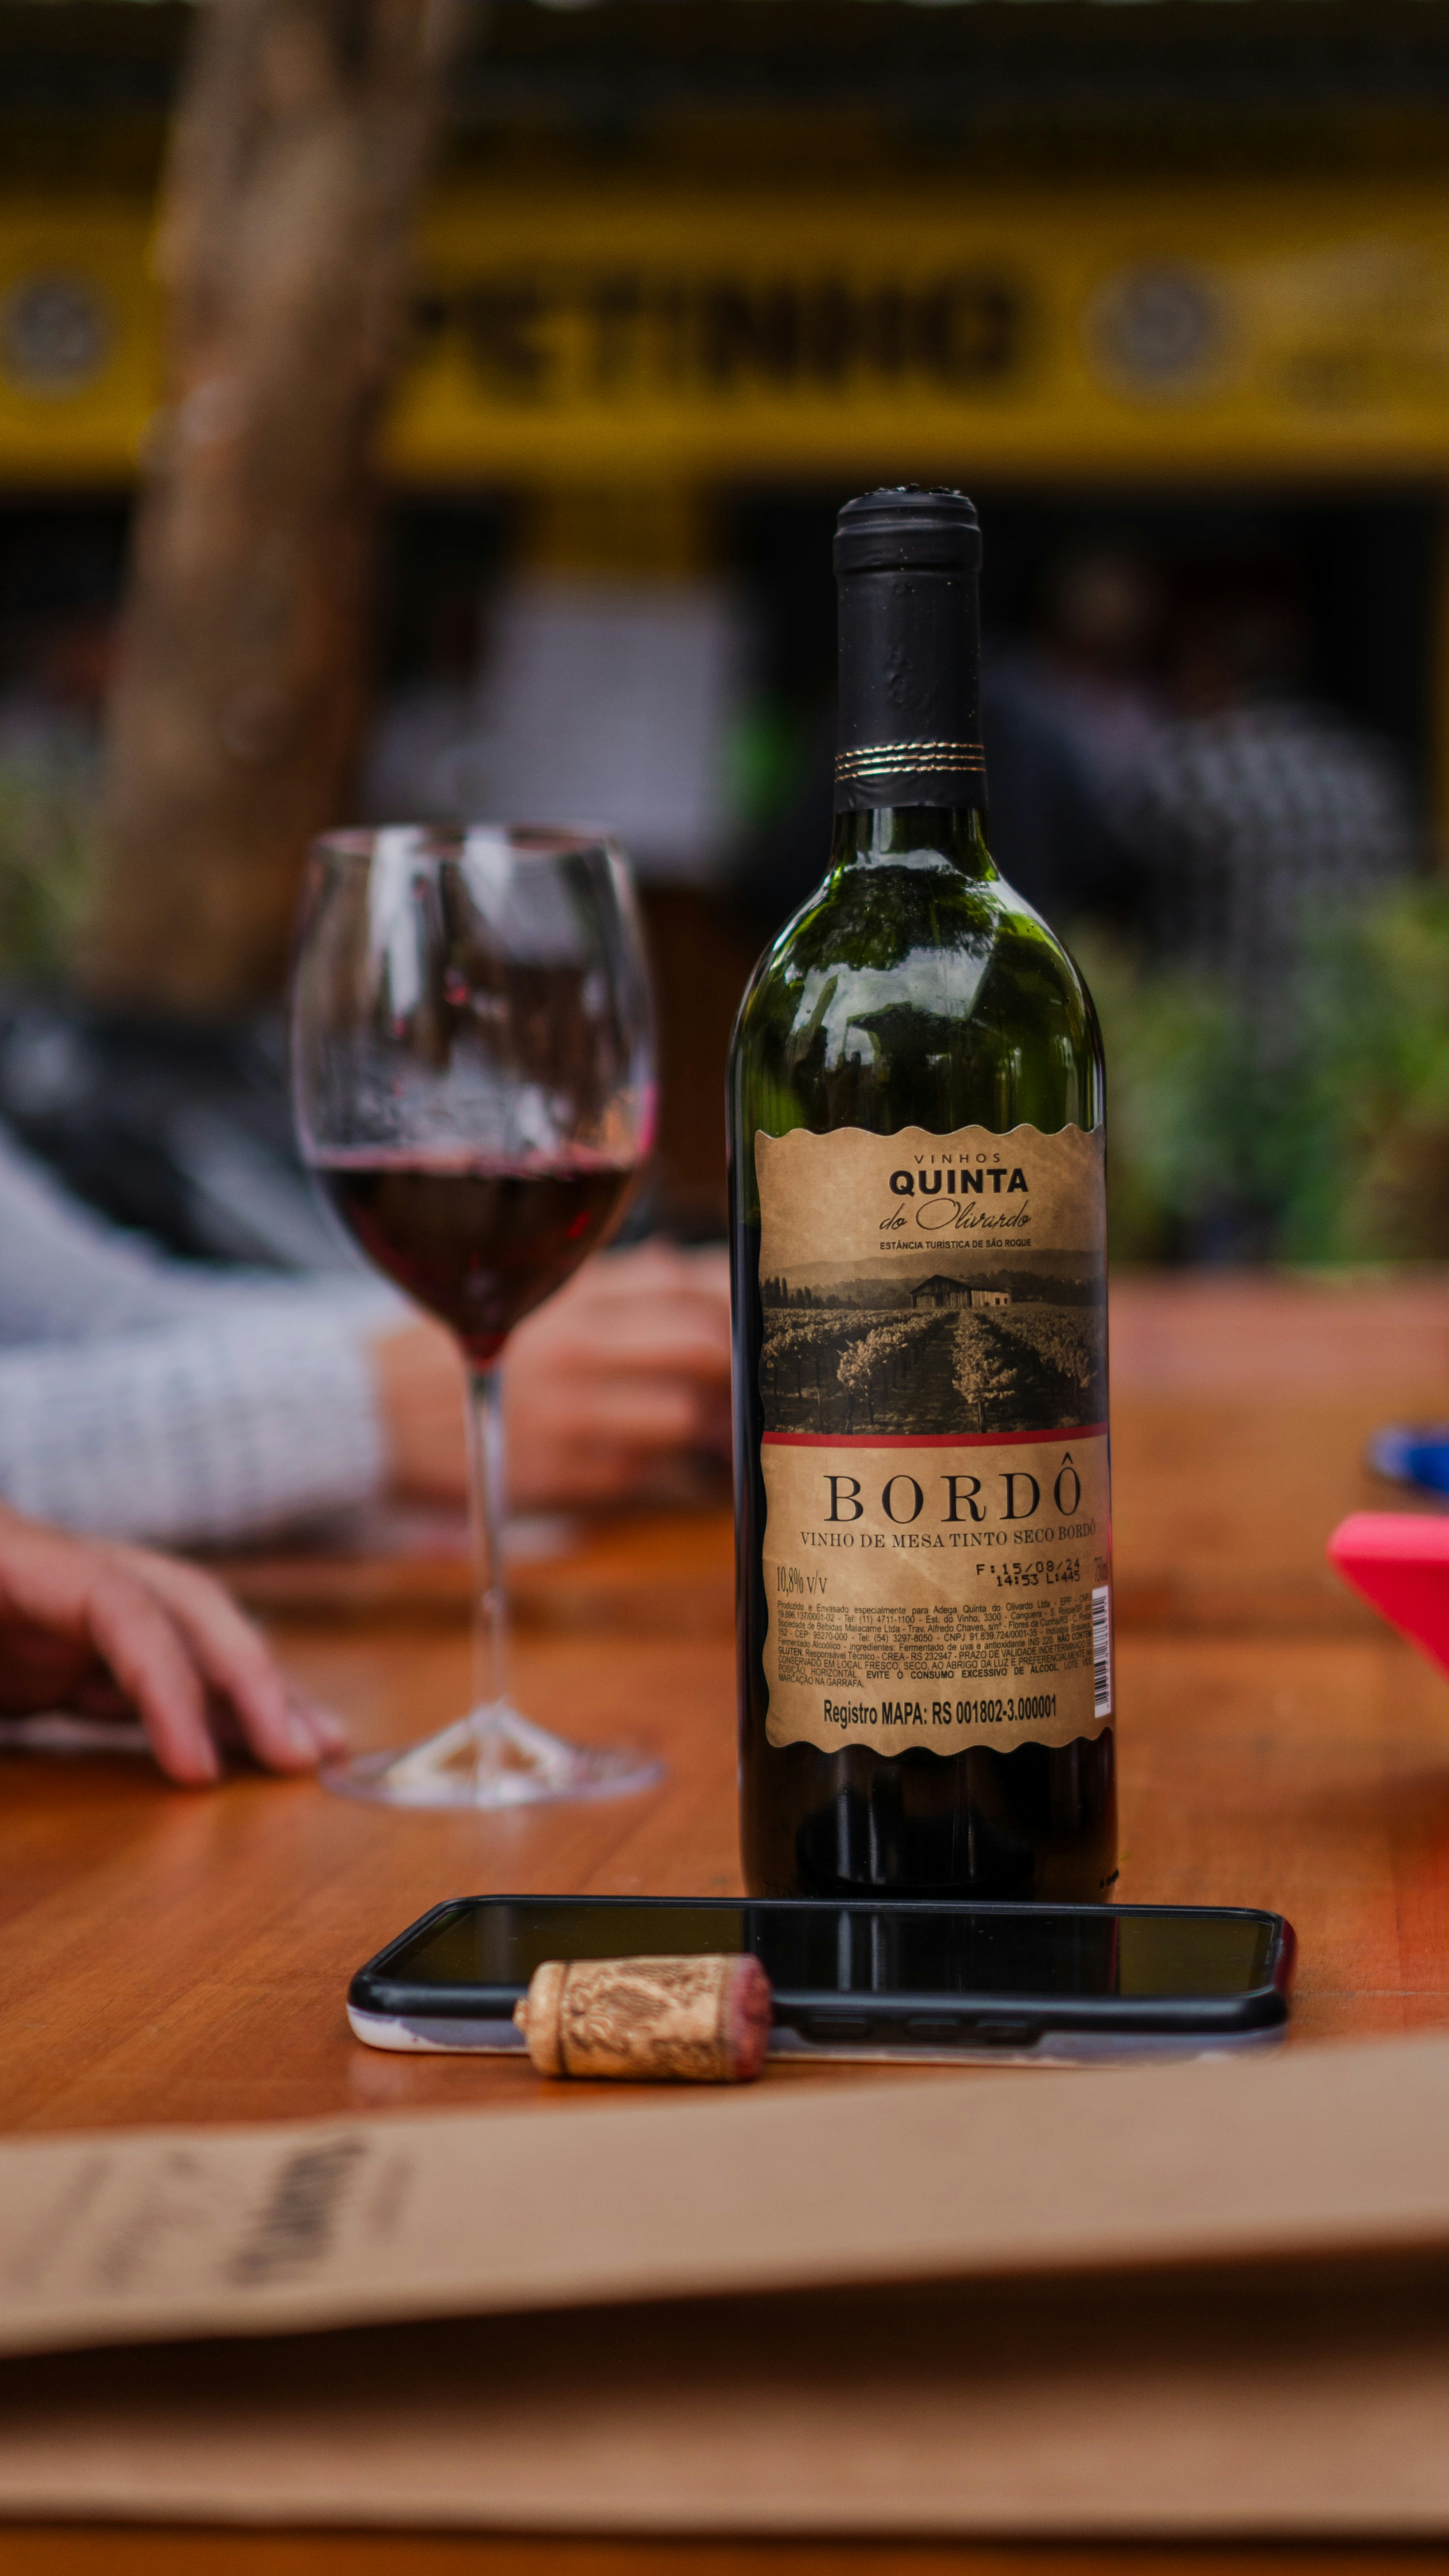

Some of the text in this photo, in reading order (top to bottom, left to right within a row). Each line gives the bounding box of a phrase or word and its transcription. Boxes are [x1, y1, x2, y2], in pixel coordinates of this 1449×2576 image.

[914, 1153, 1000, 1164] VINHOS
[889, 1168, 1028, 1197] QUINTA
[879, 1197, 1031, 1230] do Olivardo
[880, 1238, 1031, 1250] ESTÂNCIA TURÍSTICA DE SÃO ROQUE
[823, 1452, 1081, 1524] BORDÔ
[800, 1518, 1096, 1548] VINHO DE MESA TINTO SECO BORDÔ
[777, 1566, 803, 1597] 10,8%
[997, 1574, 1038, 1587] 14:53
[777, 1601, 803, 1611] Produzido
[816, 1604, 848, 1613] Envasado
[854, 1606, 906, 1616] especialmente
[912, 1607, 928, 1616] para
[933, 1606, 957, 1615] Adega
[963, 1605, 986, 1613] Quinta
[1006, 1602, 1033, 1610] Olivardo
[1037, 1600, 1050, 1608] Ltda
[1060, 1597, 1071, 1605] EPP
[778, 1619, 806, 1628] Sociedade
[817, 1623, 842, 1631] Bebidas
[859, 1616, 872, 1625] (11)
[877, 1615, 914, 1623] 4711-1100
[984, 1613, 1001, 1621] 3300
[1011, 1611, 1042, 1620] Canguera
[795, 1630, 810, 1638] CEP:
[813, 1632, 847, 1640] 95270-000
[858, 1633, 869, 1642] Tel:
[874, 1634, 888, 1644] (54)
[893, 1634, 932, 1642] 3297-8050
[944, 1633, 965, 1642] CNPJ
[778, 1637, 810, 1648] Fermentado
[812, 1641, 840, 1650] Alcoólico
[850, 1643, 895, 1652] Ingredientes:
[984, 1640, 1025, 1649] antioxidante
[806, 1648, 846, 1660] Responsável
[882, 1652, 904, 1661] CREA
[925, 1652, 952, 1660] 232947
[959, 1651, 986, 1659] PRAZO
[989, 1650, 999, 1658] DE
[1002, 1647, 1037, 1657] VALIDADE
[778, 1655, 821, 1667] CONSERVADO
[837, 1660, 862, 1669] LOCAL
[946, 1660, 977, 1669] ABRIGO
[994, 1659, 1008, 1667] LUZ
[1011, 1658, 1016, 1666] E
[867, 1670, 889, 1679] EVITE
[911, 1670, 954, 1679] CONSUMO
[962, 1668, 1007, 1678] EXCESSIVO
[1014, 1667, 1024, 1675] DE
[1064, 1660, 1078, 1670] LOTE
[778, 1673, 813, 1685] MARCAÇÃO
[826, 1678, 864, 1687] GARRAFA.
[824, 1694, 1056, 1729] Registro MAPA: RS 001802-3.000001
